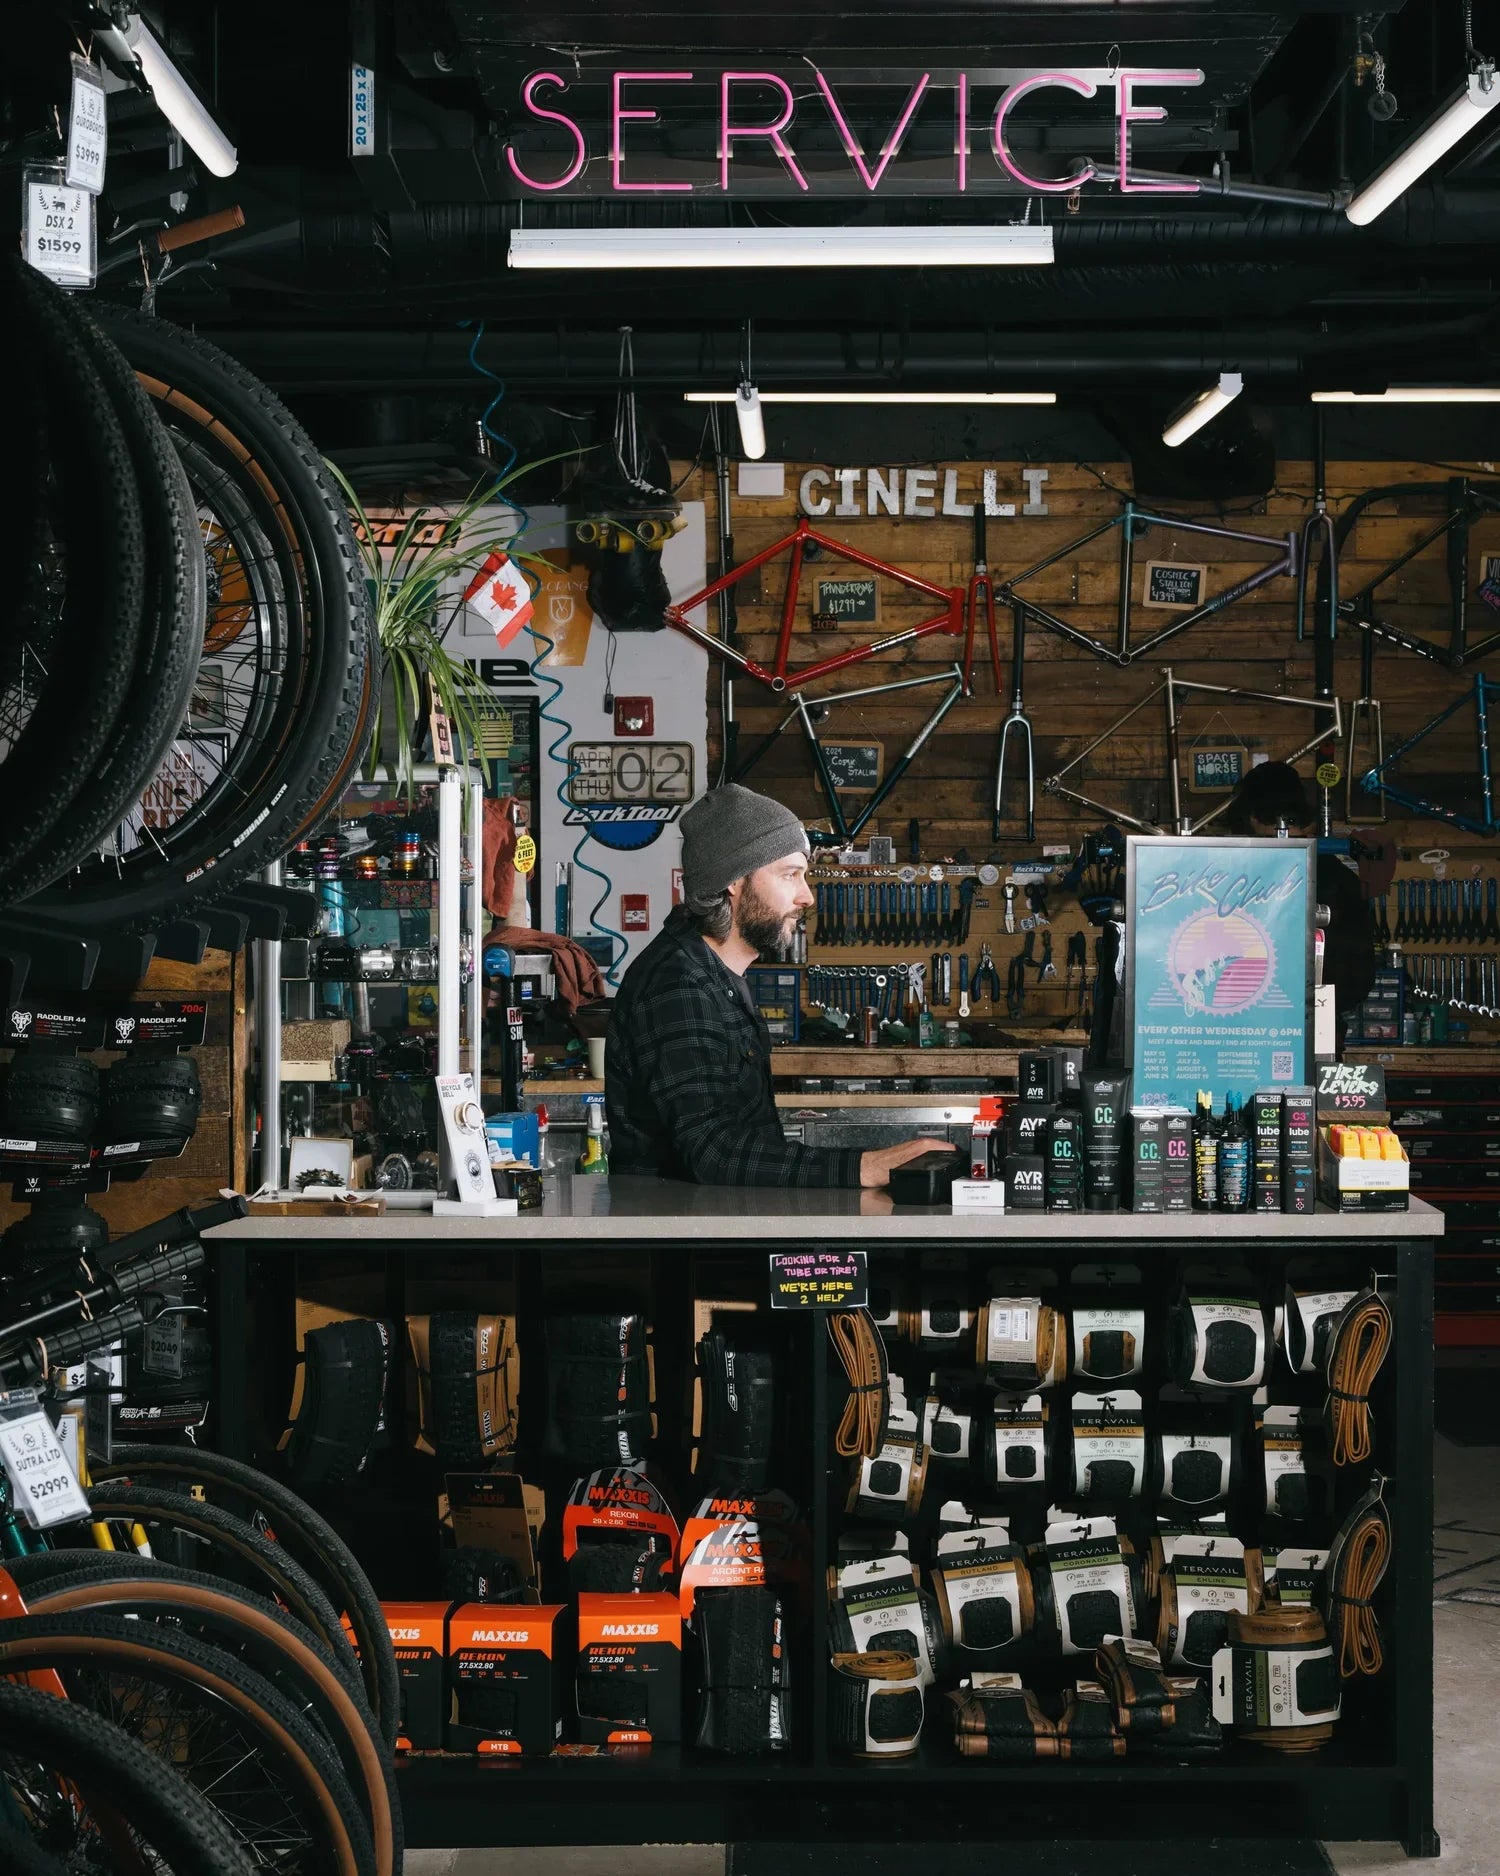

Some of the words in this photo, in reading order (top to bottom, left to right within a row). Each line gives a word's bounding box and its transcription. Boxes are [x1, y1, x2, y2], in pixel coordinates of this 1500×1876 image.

[356, 68, 366, 78] 2
[356, 93, 366, 111] 25
[356, 127, 366, 145] 20
[507, 72, 1201, 192] SERVICE
[75, 145, 100, 165] $3999
[46, 215, 65, 229] DSX
[67, 217, 74, 229] 2
[38, 238, 81, 253] $1599
[800, 469, 1049, 516] CINELLI
[578, 752, 608, 769] APR
[1198, 753, 1238, 764] SPACE
[617, 752, 686, 793] 02
[1198, 763, 1238, 774] HORSE
[577, 779, 608, 795] THU
[523, 849, 533, 858] FEET
[1140, 863, 1229, 915] Bike
[1217, 864, 1303, 917] Club
[182, 1004, 204, 1013] 700c
[37, 1013, 74, 1022] RADDLER
[1138, 1026, 1169, 1034] EVERY
[1170, 1026, 1202, 1035] OTHER
[1205, 1026, 1267, 1036] WEDNESDAY
[1269, 1028, 1278, 1038] @
[1280, 1028, 1302, 1036] 6PM
[1320, 1064, 1368, 1081] TIRE
[441, 1084, 461, 1092] BICYCLE
[1027, 1088, 1044, 1096] AYR
[1319, 1079, 1379, 1096] LEVERS
[1257, 1126, 1280, 1136] lube
[1289, 1128, 1310, 1136] lube
[1014, 1171, 1043, 1184] AYR
[776, 1255, 815, 1266] LOOKING
[819, 1255, 840, 1263] FOR
[847, 1255, 854, 1263] A
[784, 1268, 812, 1277] TUBE
[830, 1266, 858, 1276] TIRE?
[780, 1282, 818, 1292] WE'RE
[822, 1282, 854, 1290] HERE
[800, 1295, 808, 1304] 2
[816, 1294, 844, 1302] HELP
[151, 1341, 178, 1354] $2049
[16, 1454, 45, 1472] SUTRA
[46, 1448, 60, 1462] LTD
[30, 1476, 68, 1499] $2999
[588, 1486, 651, 1505] MAXXIS
[610, 1510, 639, 1520] REKON
[706, 1543, 762, 1557] MAXX
[1056, 1547, 1112, 1558] TERAVAIL
[950, 1554, 1006, 1568] TERAVAIL
[1064, 1557, 1108, 1566] CORONADO
[712, 1566, 752, 1576] ARDENT
[754, 1566, 766, 1575] RA
[961, 1566, 998, 1576] RUTLAND
[1182, 1566, 1239, 1575] TERAVAIL
[852, 1585, 909, 1600] TERAVAIL
[1124, 1568, 1134, 1621] TERAVAIL
[864, 1598, 900, 1608] HONCHO
[389, 1627, 420, 1640] XXIS
[602, 1624, 659, 1636] MAXXIS
[472, 1630, 528, 1642] MAXXIS
[589, 1646, 636, 1656] REKON
[459, 1652, 507, 1662] REKON
[589, 1656, 624, 1664] 27.5X2.80
[459, 1662, 494, 1670] 27.5X2.80
[621, 1732, 638, 1741] MTB
[491, 1742, 508, 1751] MTB
